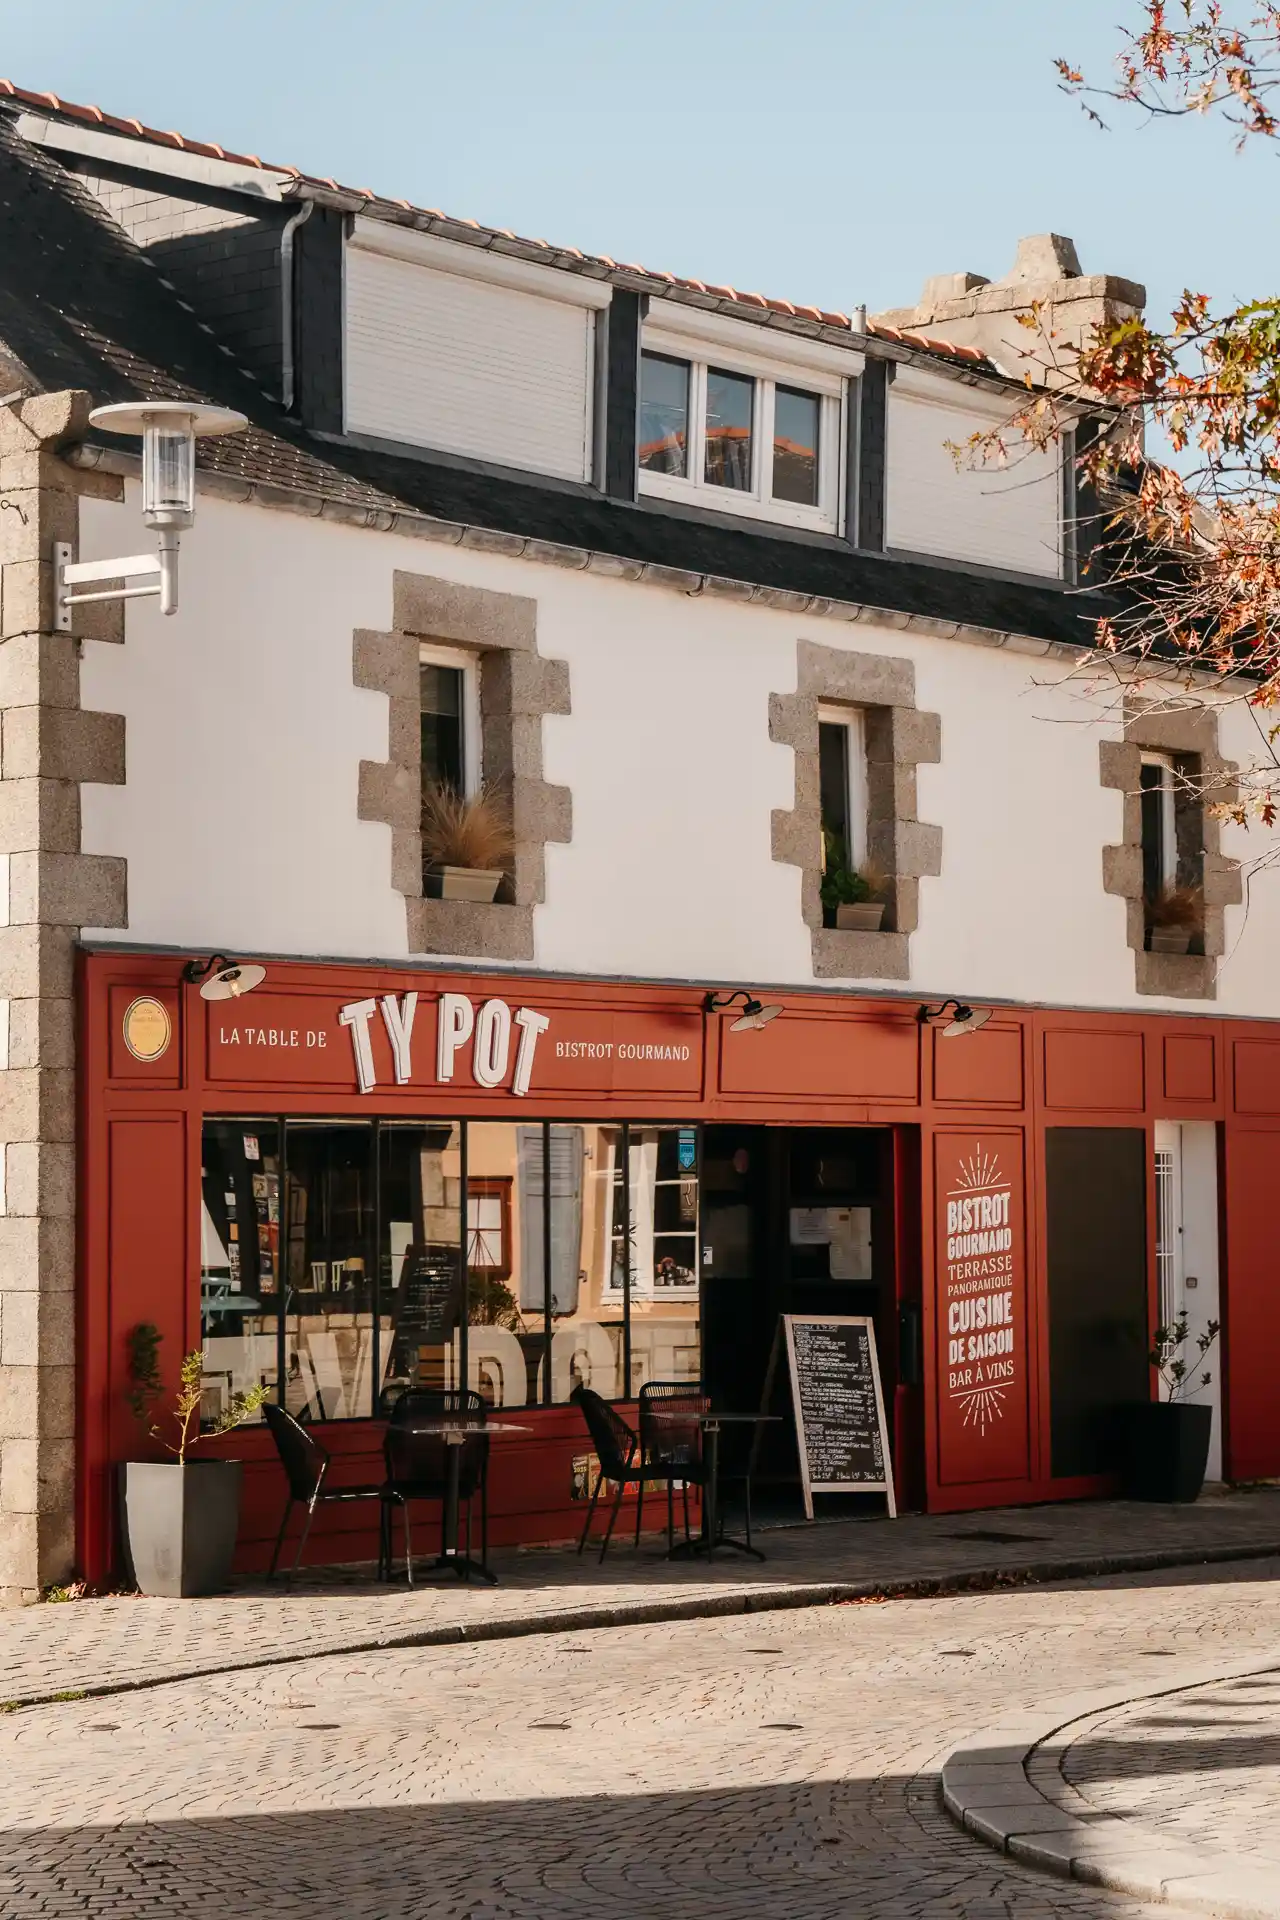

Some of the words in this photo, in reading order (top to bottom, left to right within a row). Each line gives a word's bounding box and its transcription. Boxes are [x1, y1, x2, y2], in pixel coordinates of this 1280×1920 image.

[220, 1027, 241, 1045] LA
[244, 1028, 300, 1047] TABLE
[306, 1030, 327, 1048] DE
[339, 992, 419, 1095] TY
[436, 993, 550, 1097] POT
[556, 1042, 614, 1059] BISTROT
[618, 1044, 690, 1061] GOURMAND
[947, 1191, 1011, 1235] BISTROT
[947, 1227, 1012, 1261] GOURMAND
[947, 1254, 1013, 1281] TERRASSE
[947, 1273, 1013, 1297] PANORAMIQUE
[948, 1291, 1014, 1335] CUISINE
[948, 1337, 966, 1366] DE
[967, 1327, 1014, 1361] SAISON
[949, 1368, 973, 1389] BAR
[975, 1361, 984, 1383] À
[986, 1359, 1014, 1380] VINS
